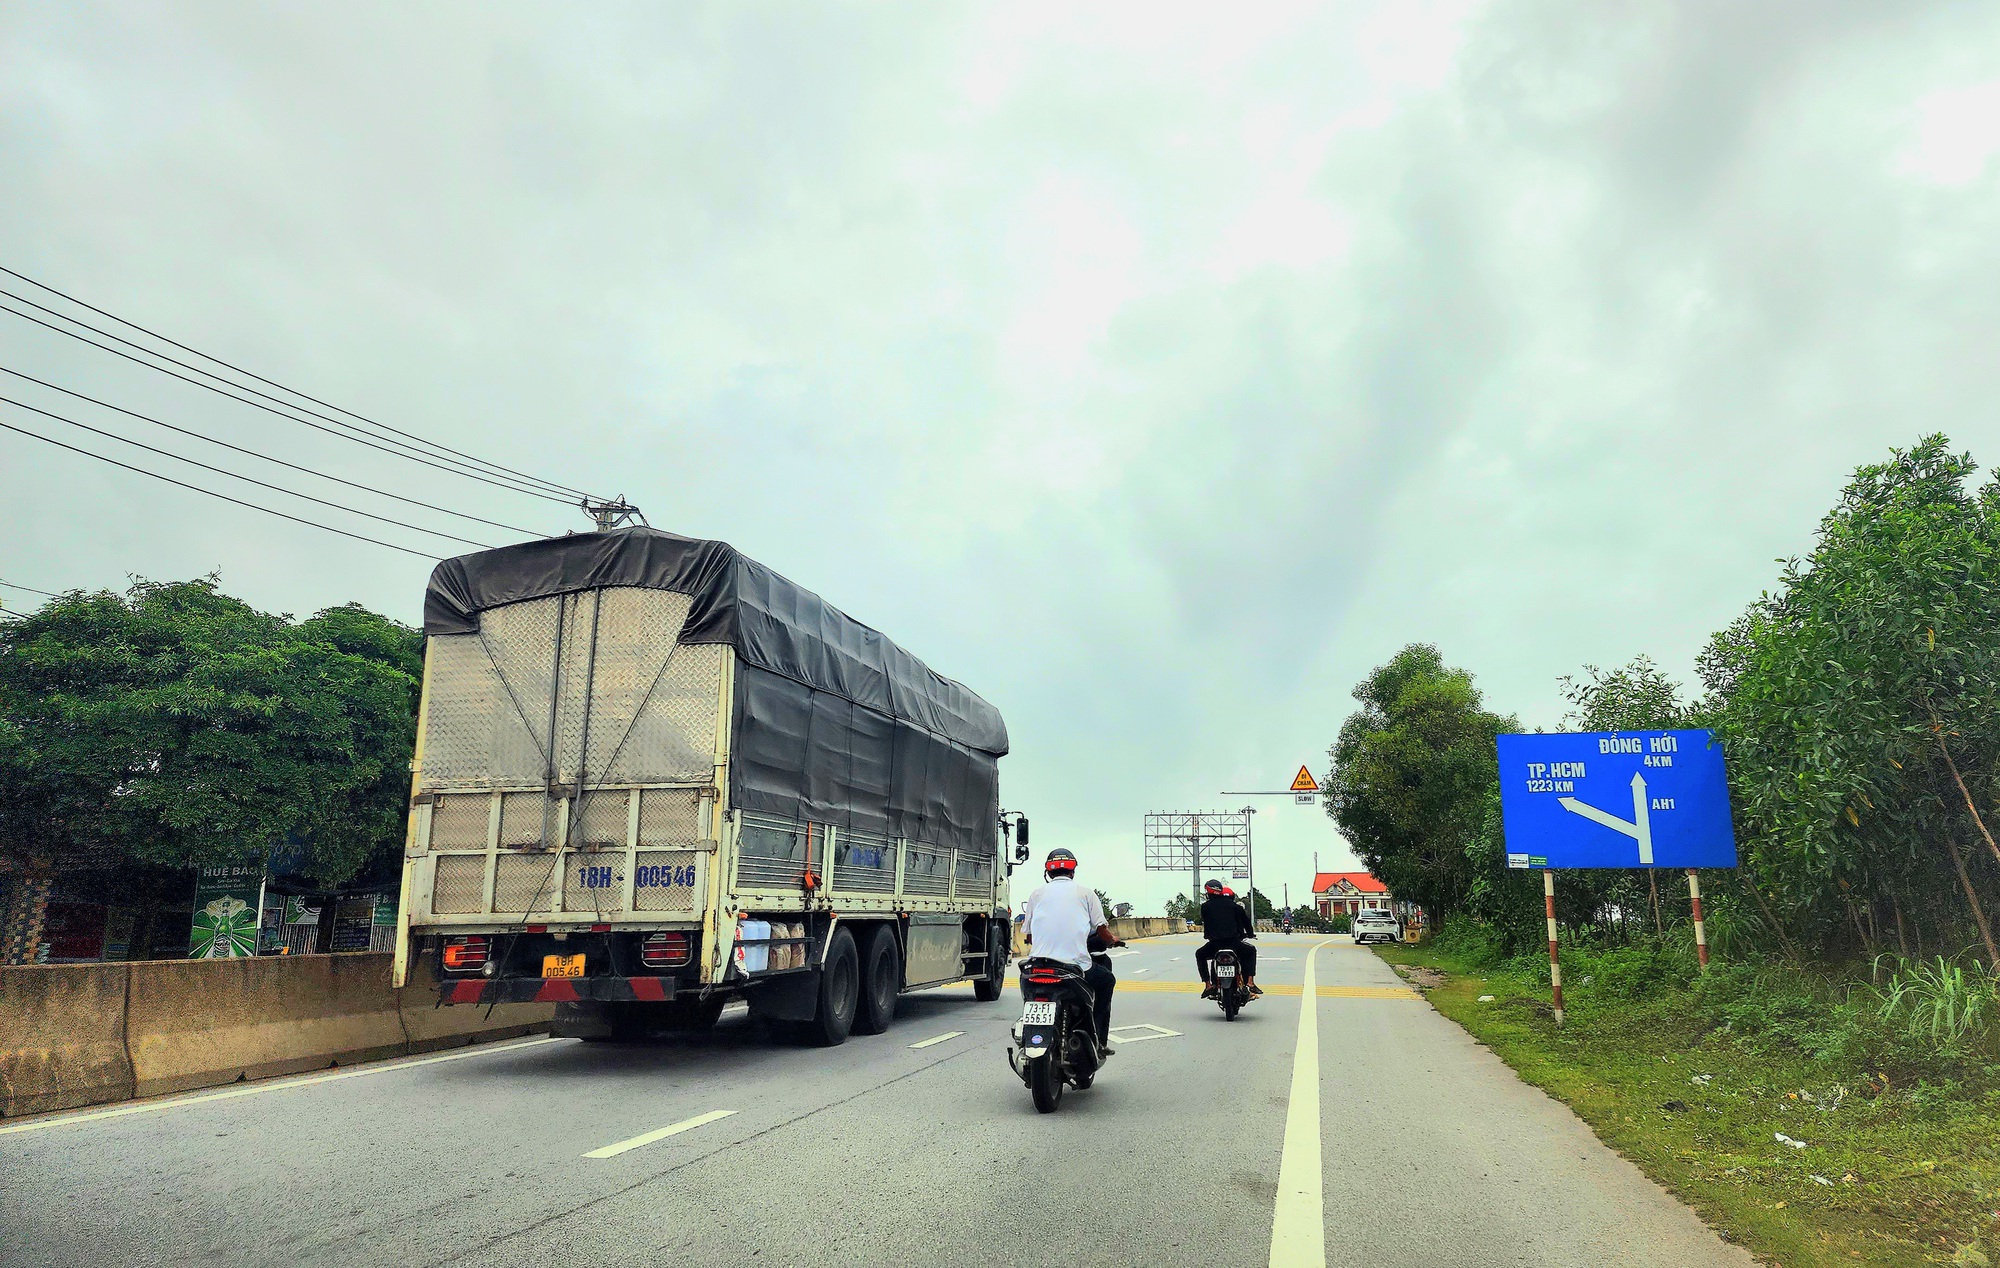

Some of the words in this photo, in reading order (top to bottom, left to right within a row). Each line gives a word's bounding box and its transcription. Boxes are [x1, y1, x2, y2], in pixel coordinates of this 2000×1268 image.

[1599, 732, 1642, 754] ĐỒNG
[1649, 732, 1678, 753] HỚI
[1527, 762, 1586, 778] TP.HCM
[1652, 798, 1675, 810] AH1
[555, 956, 574, 966] 18H
[546, 966, 580, 977] 005.46
[1028, 1003, 1050, 1014] 73-F1
[1024, 1013, 1052, 1024] 556.51
